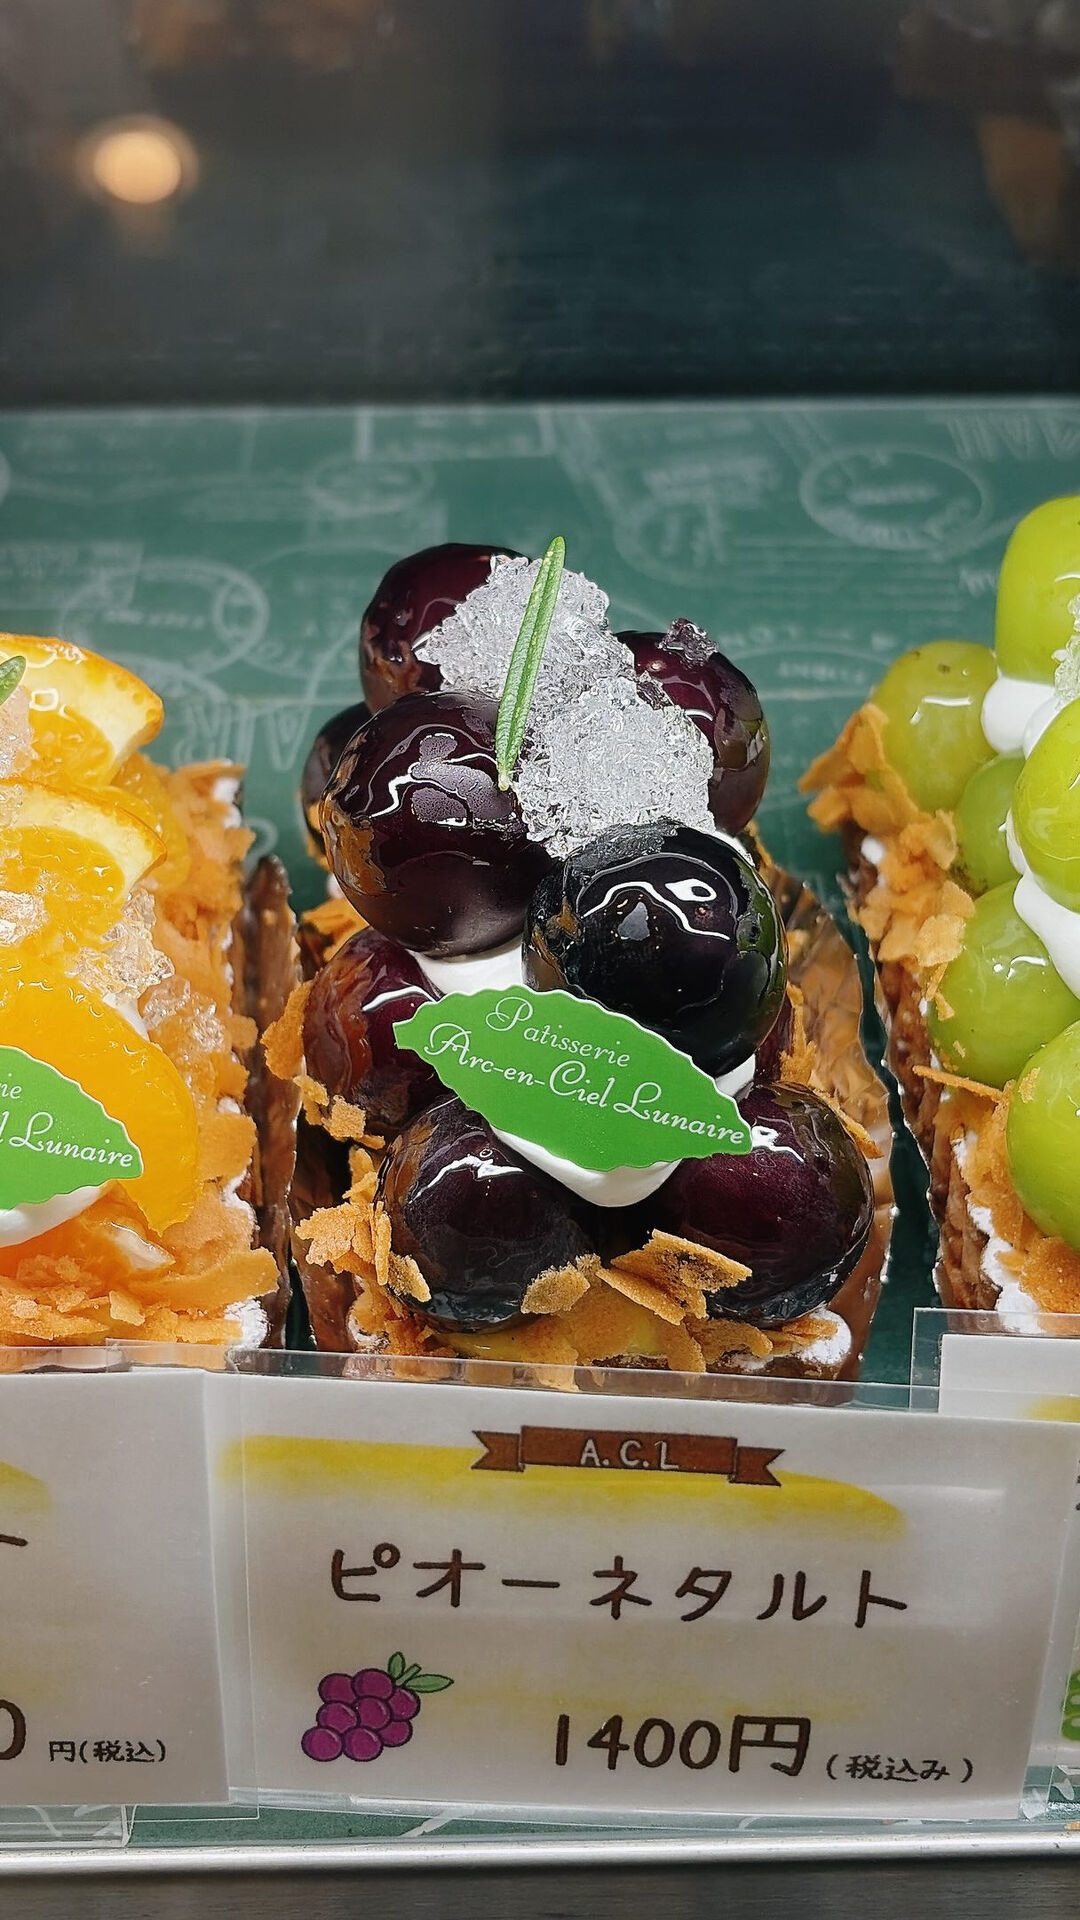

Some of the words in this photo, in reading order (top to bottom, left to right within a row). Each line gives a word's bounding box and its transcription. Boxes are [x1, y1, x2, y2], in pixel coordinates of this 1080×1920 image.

[485, 996, 631, 1068] Patisserie
[423, 1022, 616, 1108] Arc-en-Ciel
[612, 1081, 746, 1145] Lunaire
[8, 1111, 133, 1167] Lunaire
[580, 1438, 680, 1470] A.C.L
[331, 1543, 907, 1628] ピオーネタルト
